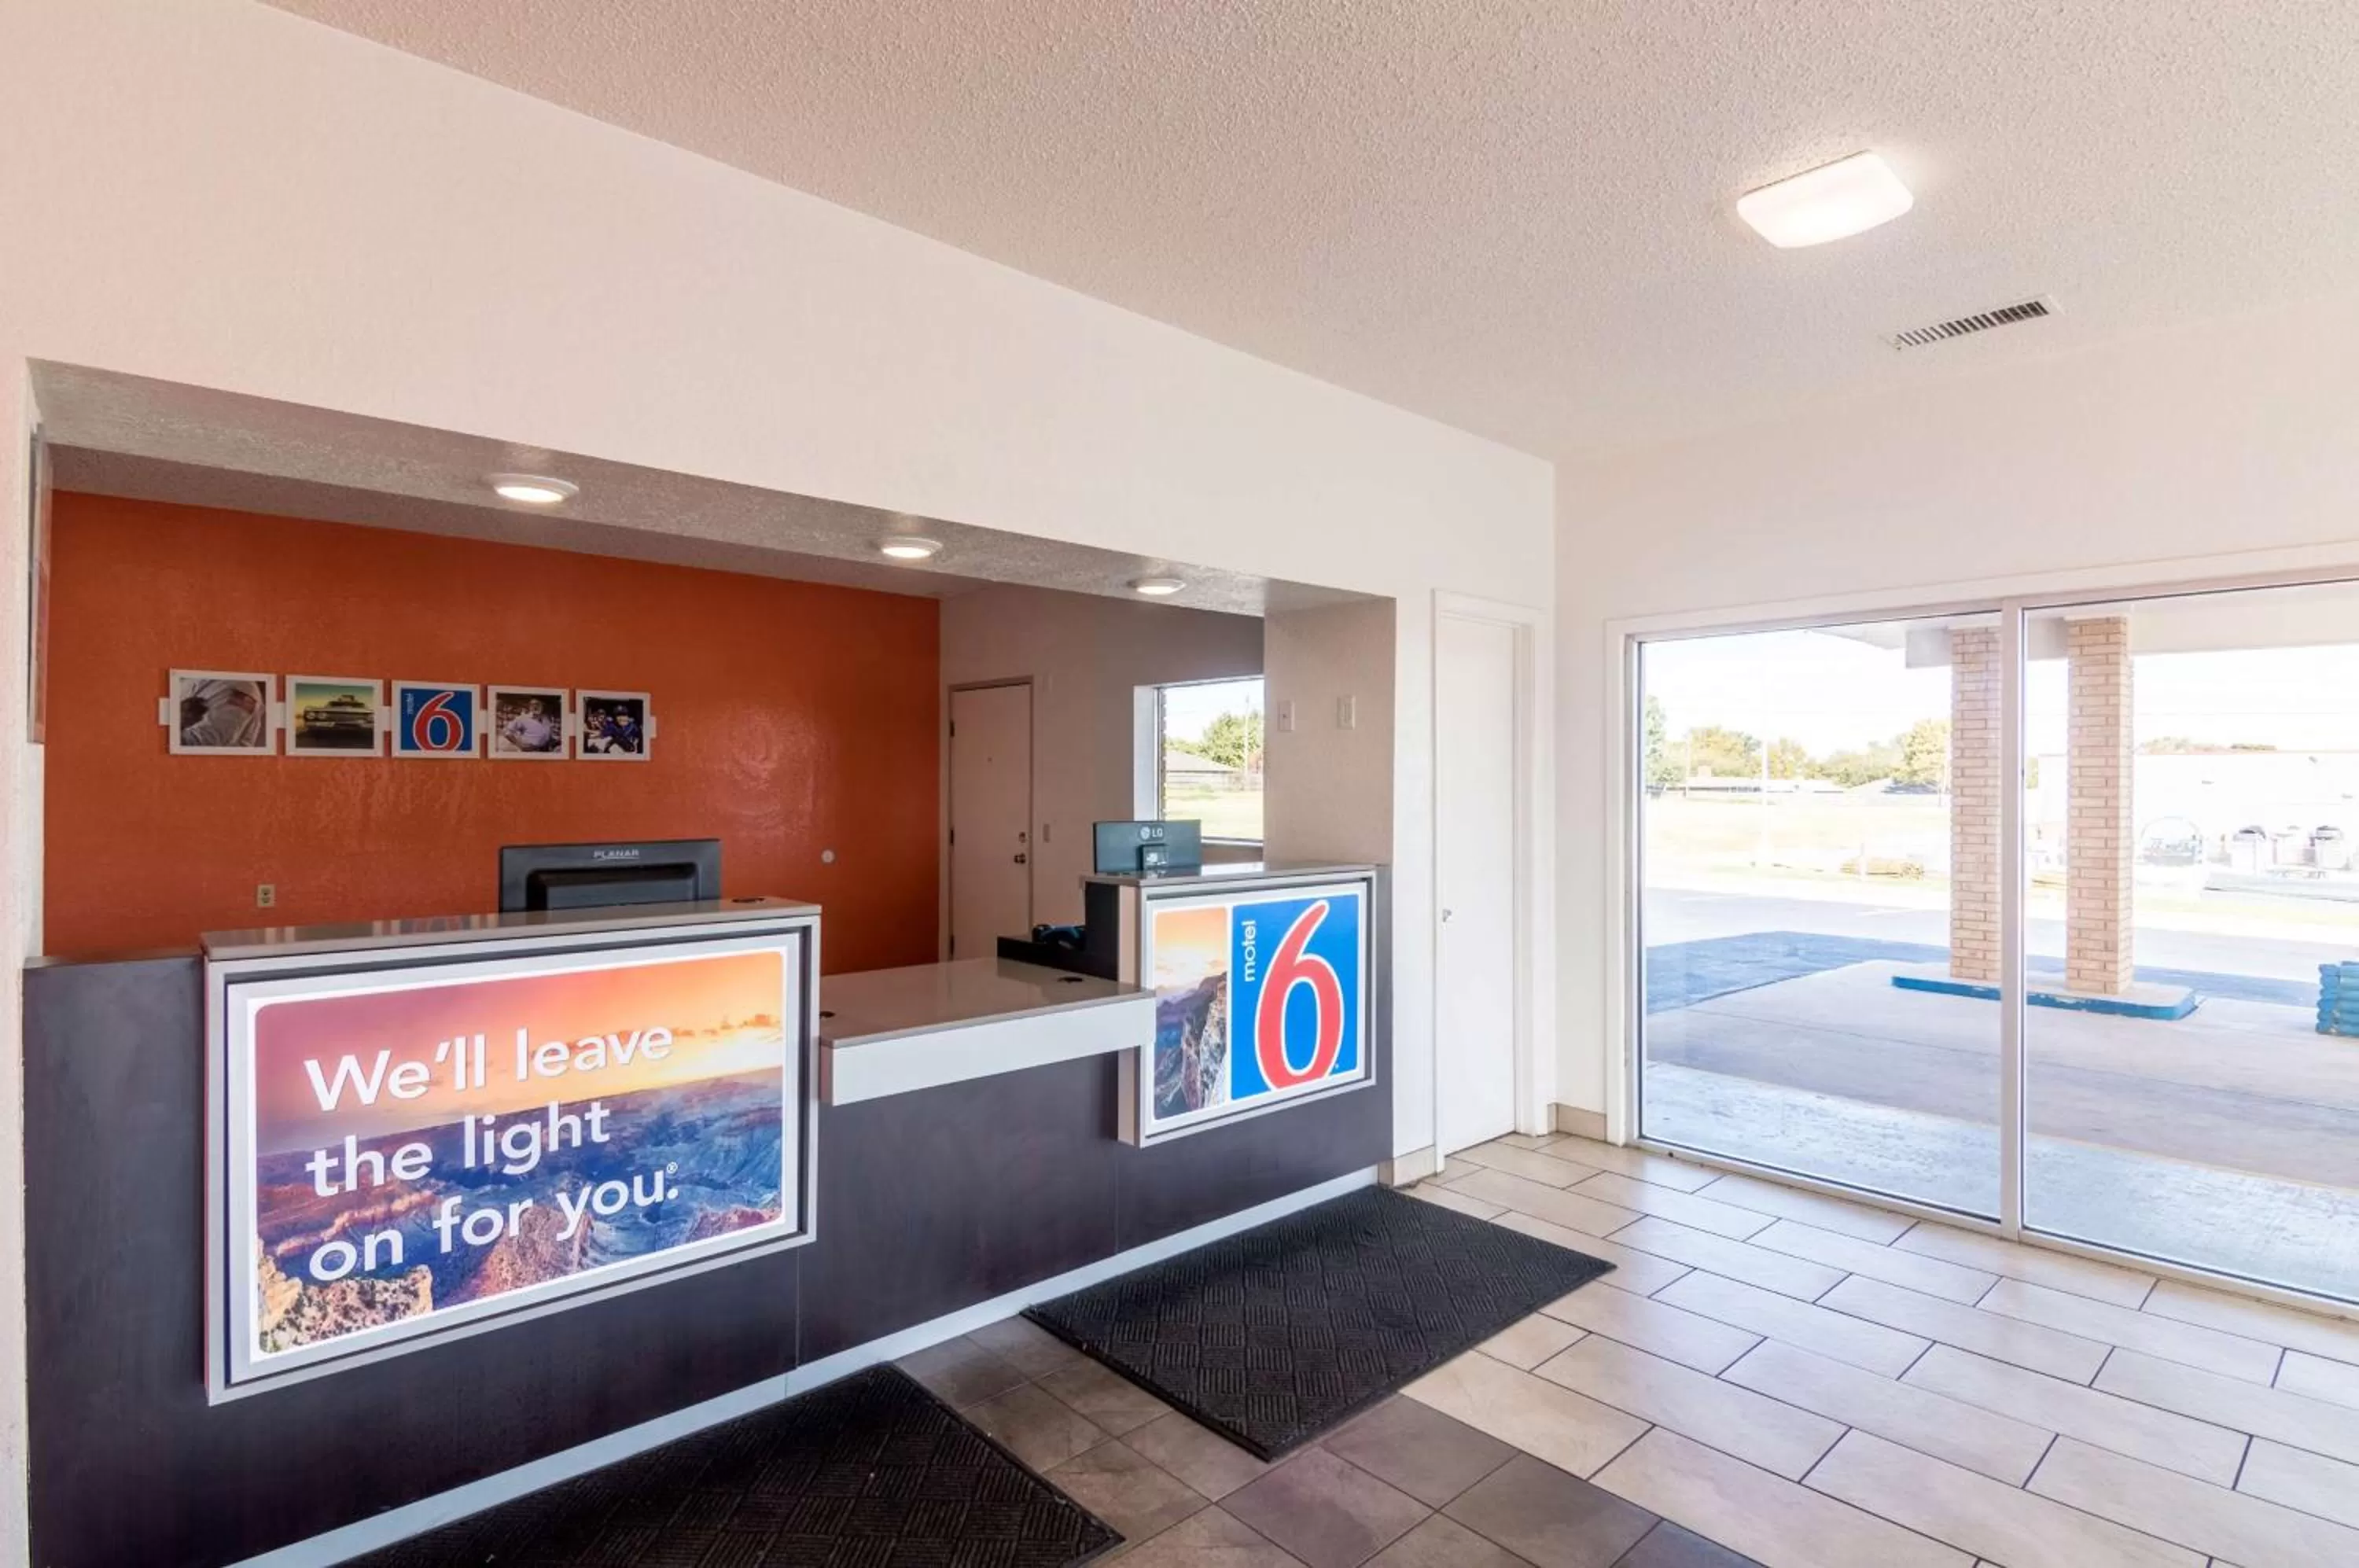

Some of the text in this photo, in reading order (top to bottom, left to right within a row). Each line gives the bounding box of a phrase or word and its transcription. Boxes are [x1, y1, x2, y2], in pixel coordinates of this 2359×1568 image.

[412, 691, 464, 752] 6
[593, 848, 639, 859] PLANAR
[1151, 828, 1163, 837] LG
[1241, 919, 1257, 983] motel
[1254, 900, 1345, 1091] 6
[304, 1026, 674, 1112] We'll leave
[305, 1100, 611, 1199] the light
[307, 1228, 404, 1282] on
[432, 1196, 534, 1254] for
